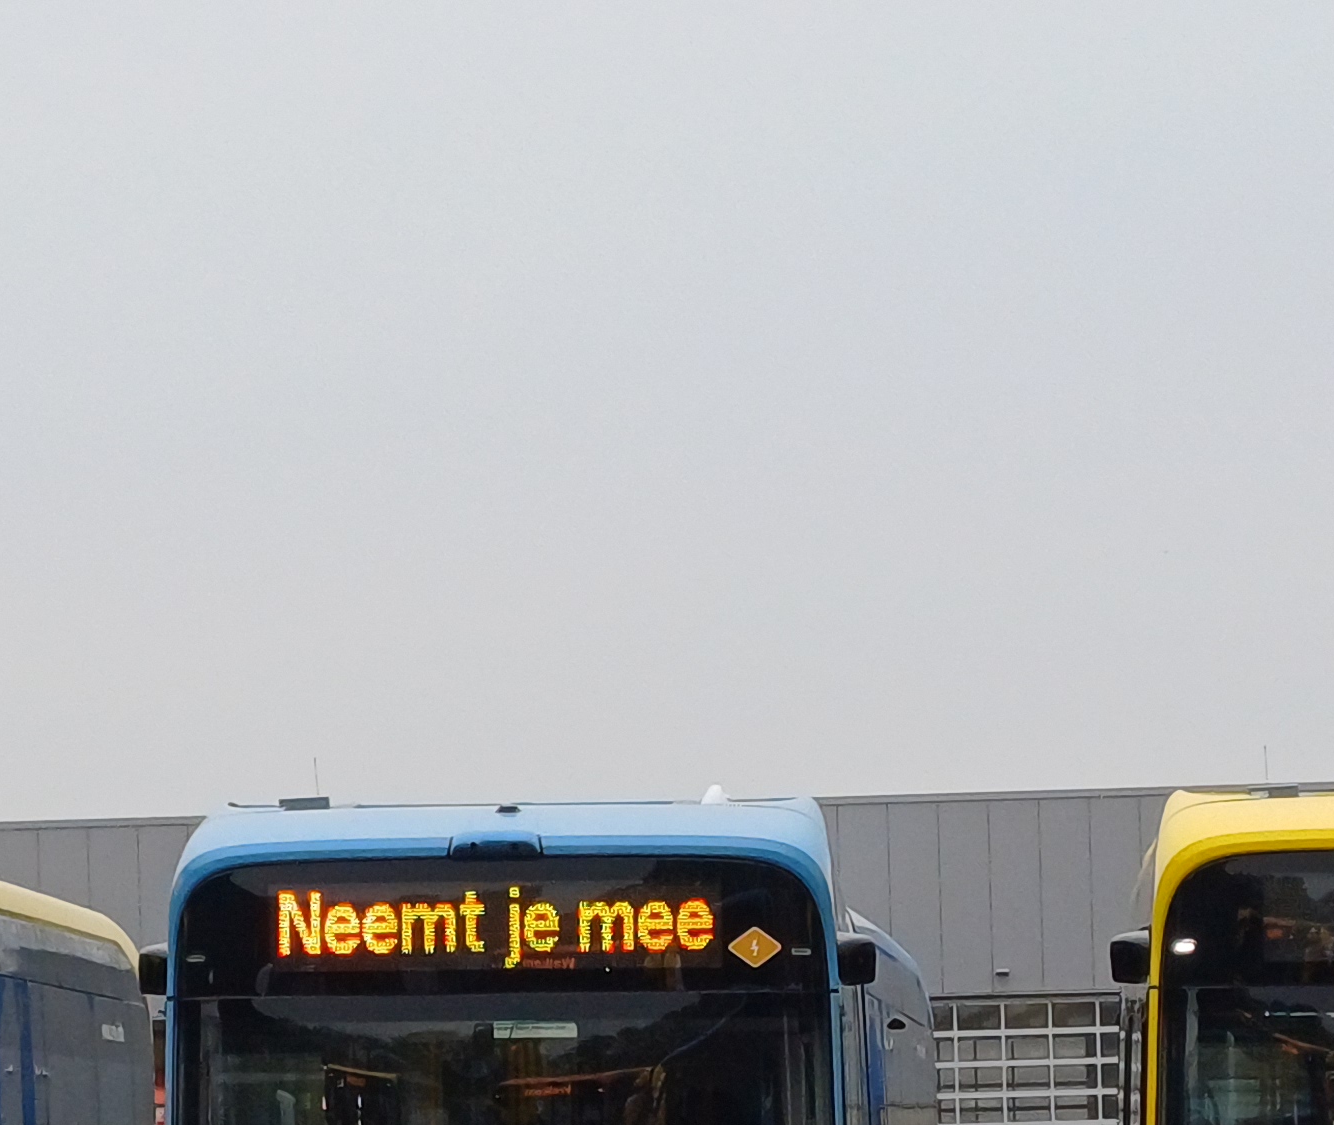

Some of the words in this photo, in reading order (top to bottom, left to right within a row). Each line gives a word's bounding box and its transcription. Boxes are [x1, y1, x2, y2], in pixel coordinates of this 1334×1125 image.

[276, 889, 485, 957] Neemt
[503, 885, 560, 970] je
[576, 896, 715, 954] mee
